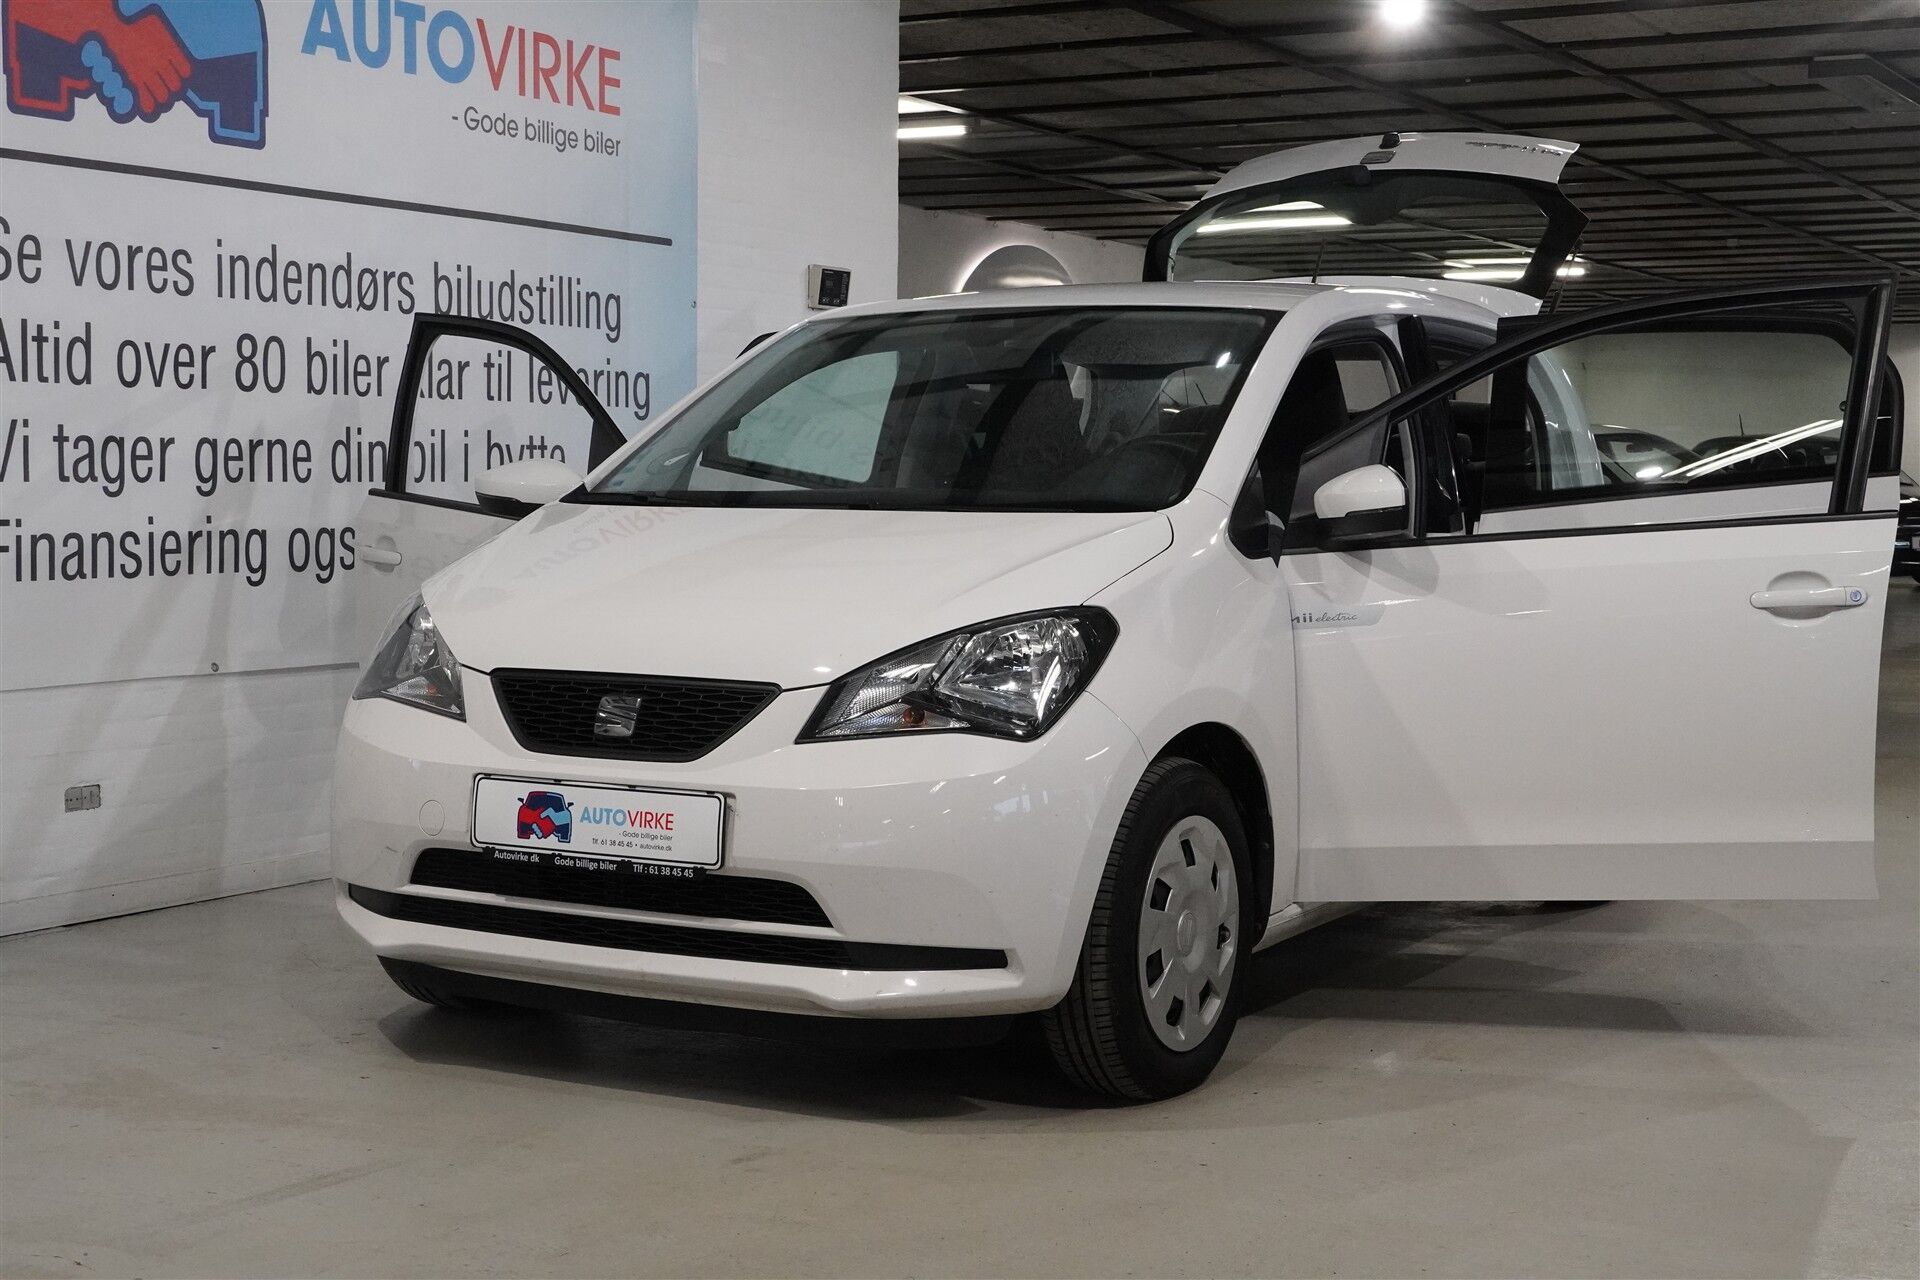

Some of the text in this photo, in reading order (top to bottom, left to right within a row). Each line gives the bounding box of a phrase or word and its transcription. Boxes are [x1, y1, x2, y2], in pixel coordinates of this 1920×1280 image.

[301, 0, 621, 116] AUTOVIRKE
[464, 106, 519, 138] Gode
[525, 117, 579, 153] billige
[584, 128, 621, 157] biler
[65, 238, 194, 297] vores
[216, 238, 415, 315] indendørs
[433, 261, 622, 343] biludstilling
[117, 339, 216, 390] over
[235, 332, 286, 394] 80
[306, 336, 389, 398] biler
[484, 350, 512, 402] til
[53, 423, 175, 498] tager
[195, 436, 312, 498] gerne
[331, 426, 387, 484] din
[463, 429, 469, 482] i
[580, 806, 674, 831] AUTOVIRKE
[609, 839, 617, 847] 38
[617, 840, 625, 848] 45
[622, 830, 640, 839] Gode
[640, 832, 659, 842] billige
[493, 850, 529, 862] Autovirke
[554, 856, 618, 871] Gode billige biler
[649, 865, 659, 874] 61
[660, 866, 671, 876] 38
[672, 867, 682, 877] 45
[684, 868, 694, 878] 45
